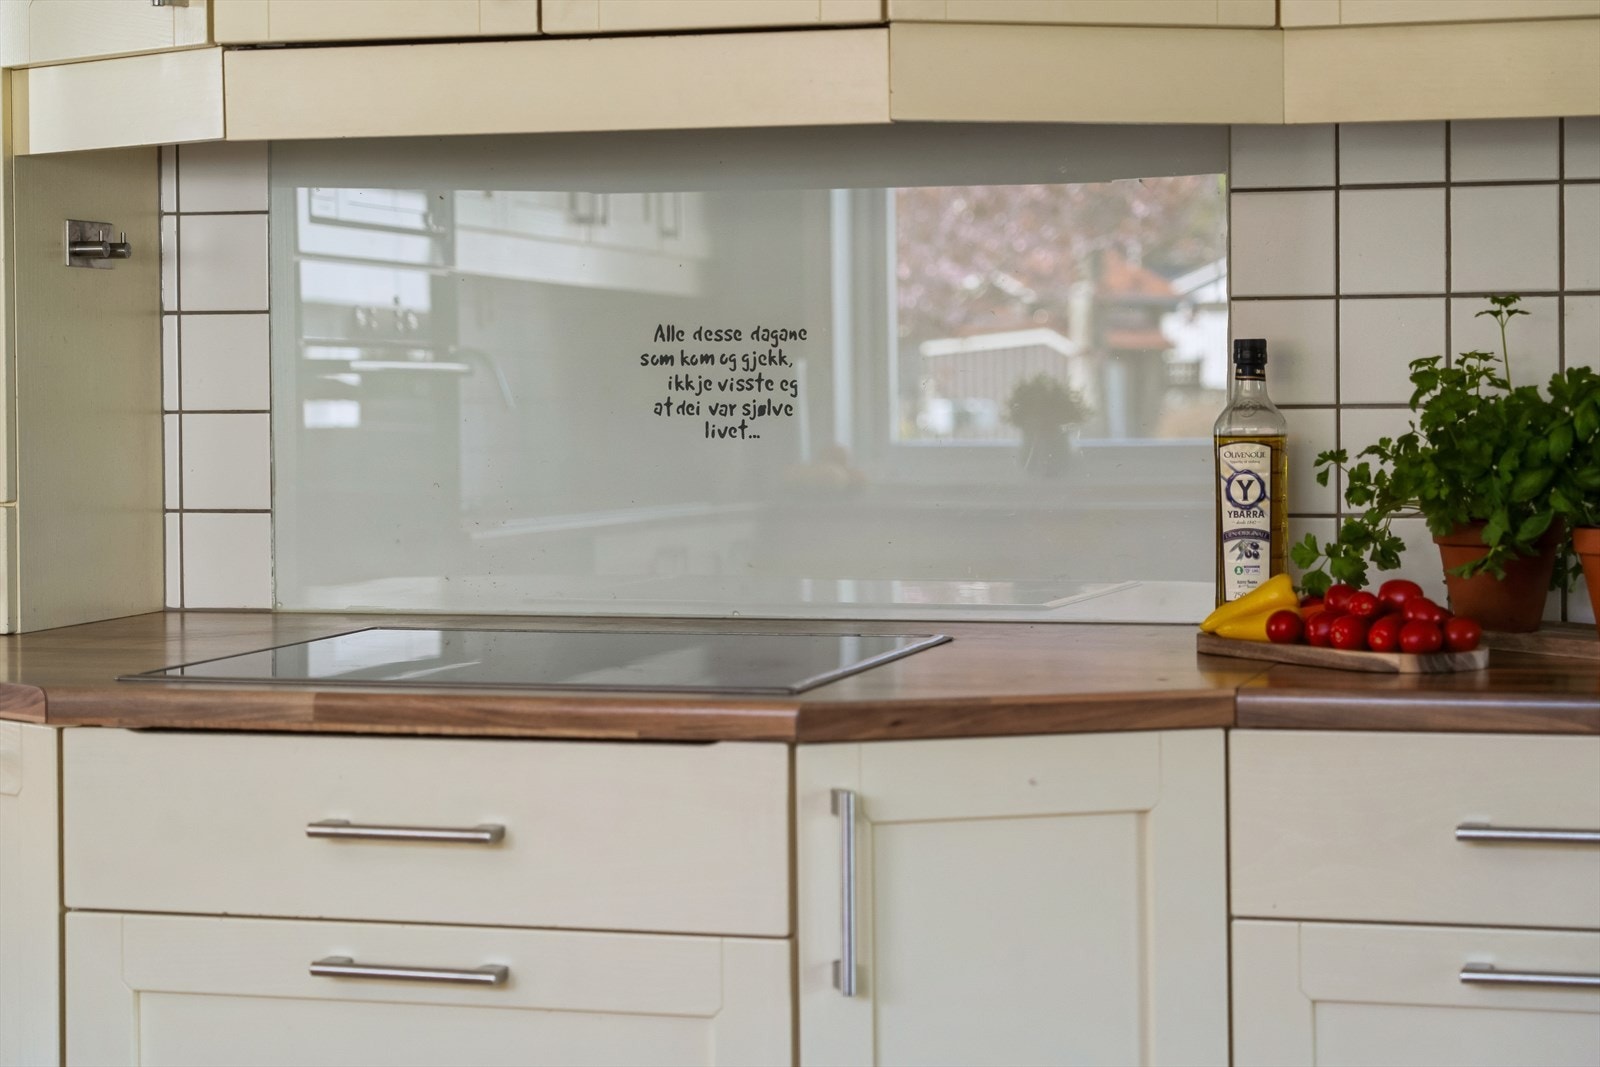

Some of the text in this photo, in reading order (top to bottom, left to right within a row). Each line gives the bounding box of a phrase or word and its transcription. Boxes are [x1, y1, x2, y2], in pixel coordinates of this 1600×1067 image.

[653, 324, 808, 349] Alle desse dagane
[640, 349, 793, 373] som kom og gjekk,
[668, 373, 798, 399] ikkje visste eg
[653, 396, 794, 421] at dei var sjølve
[705, 418, 761, 440] livet...
[1237, 480, 1255, 502] Y
[1227, 510, 1266, 519] YBARRA
